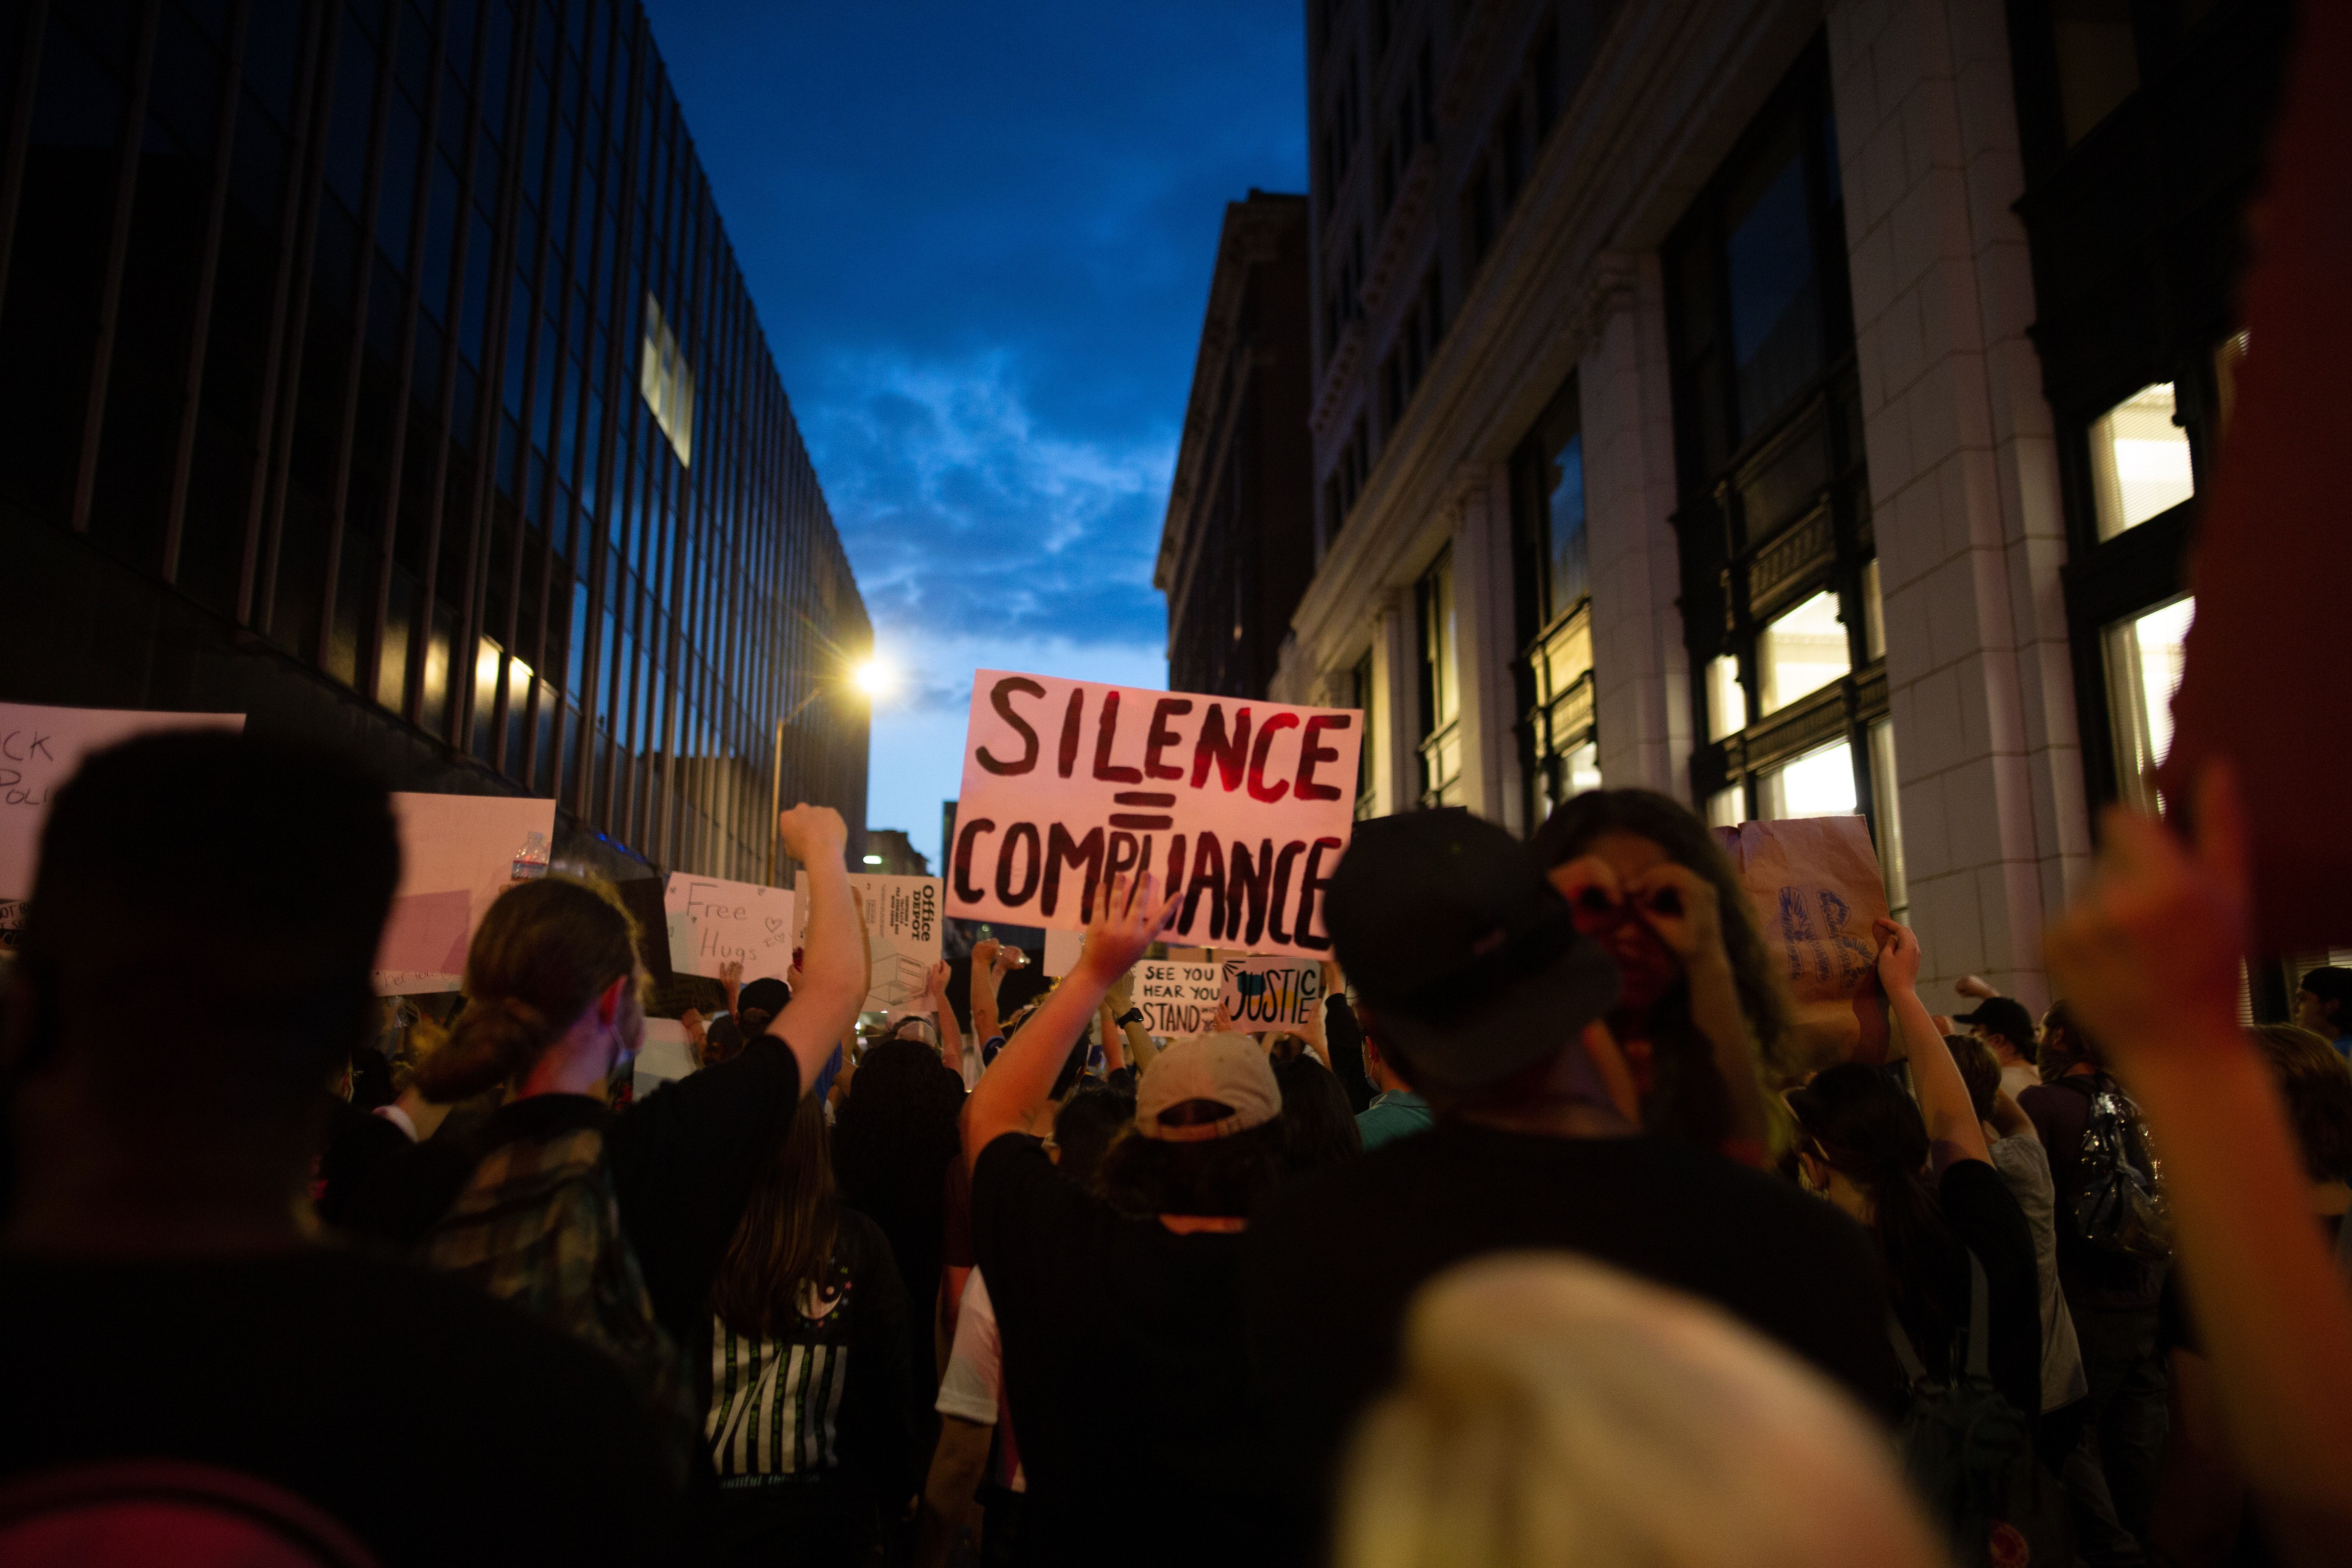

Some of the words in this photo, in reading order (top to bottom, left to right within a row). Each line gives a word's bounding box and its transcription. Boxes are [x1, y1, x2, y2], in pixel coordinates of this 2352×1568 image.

[976, 677, 1352, 803] SILENCE
[687, 882, 746, 921] Free
[953, 818, 1342, 951] COMPLIANCE
[912, 890, 921, 941] DEPOT
[922, 884, 934, 942] Office
[700, 927, 757, 962] Hugs
[1144, 984, 1185, 998] HEAR
[1189, 986, 1221, 1001] YOU
[1145, 966, 1176, 981] SEE
[1182, 967, 1215, 981] YOU
[1143, 1002, 1200, 1033] STAND
[1230, 969, 1316, 1025] JUSTICE
